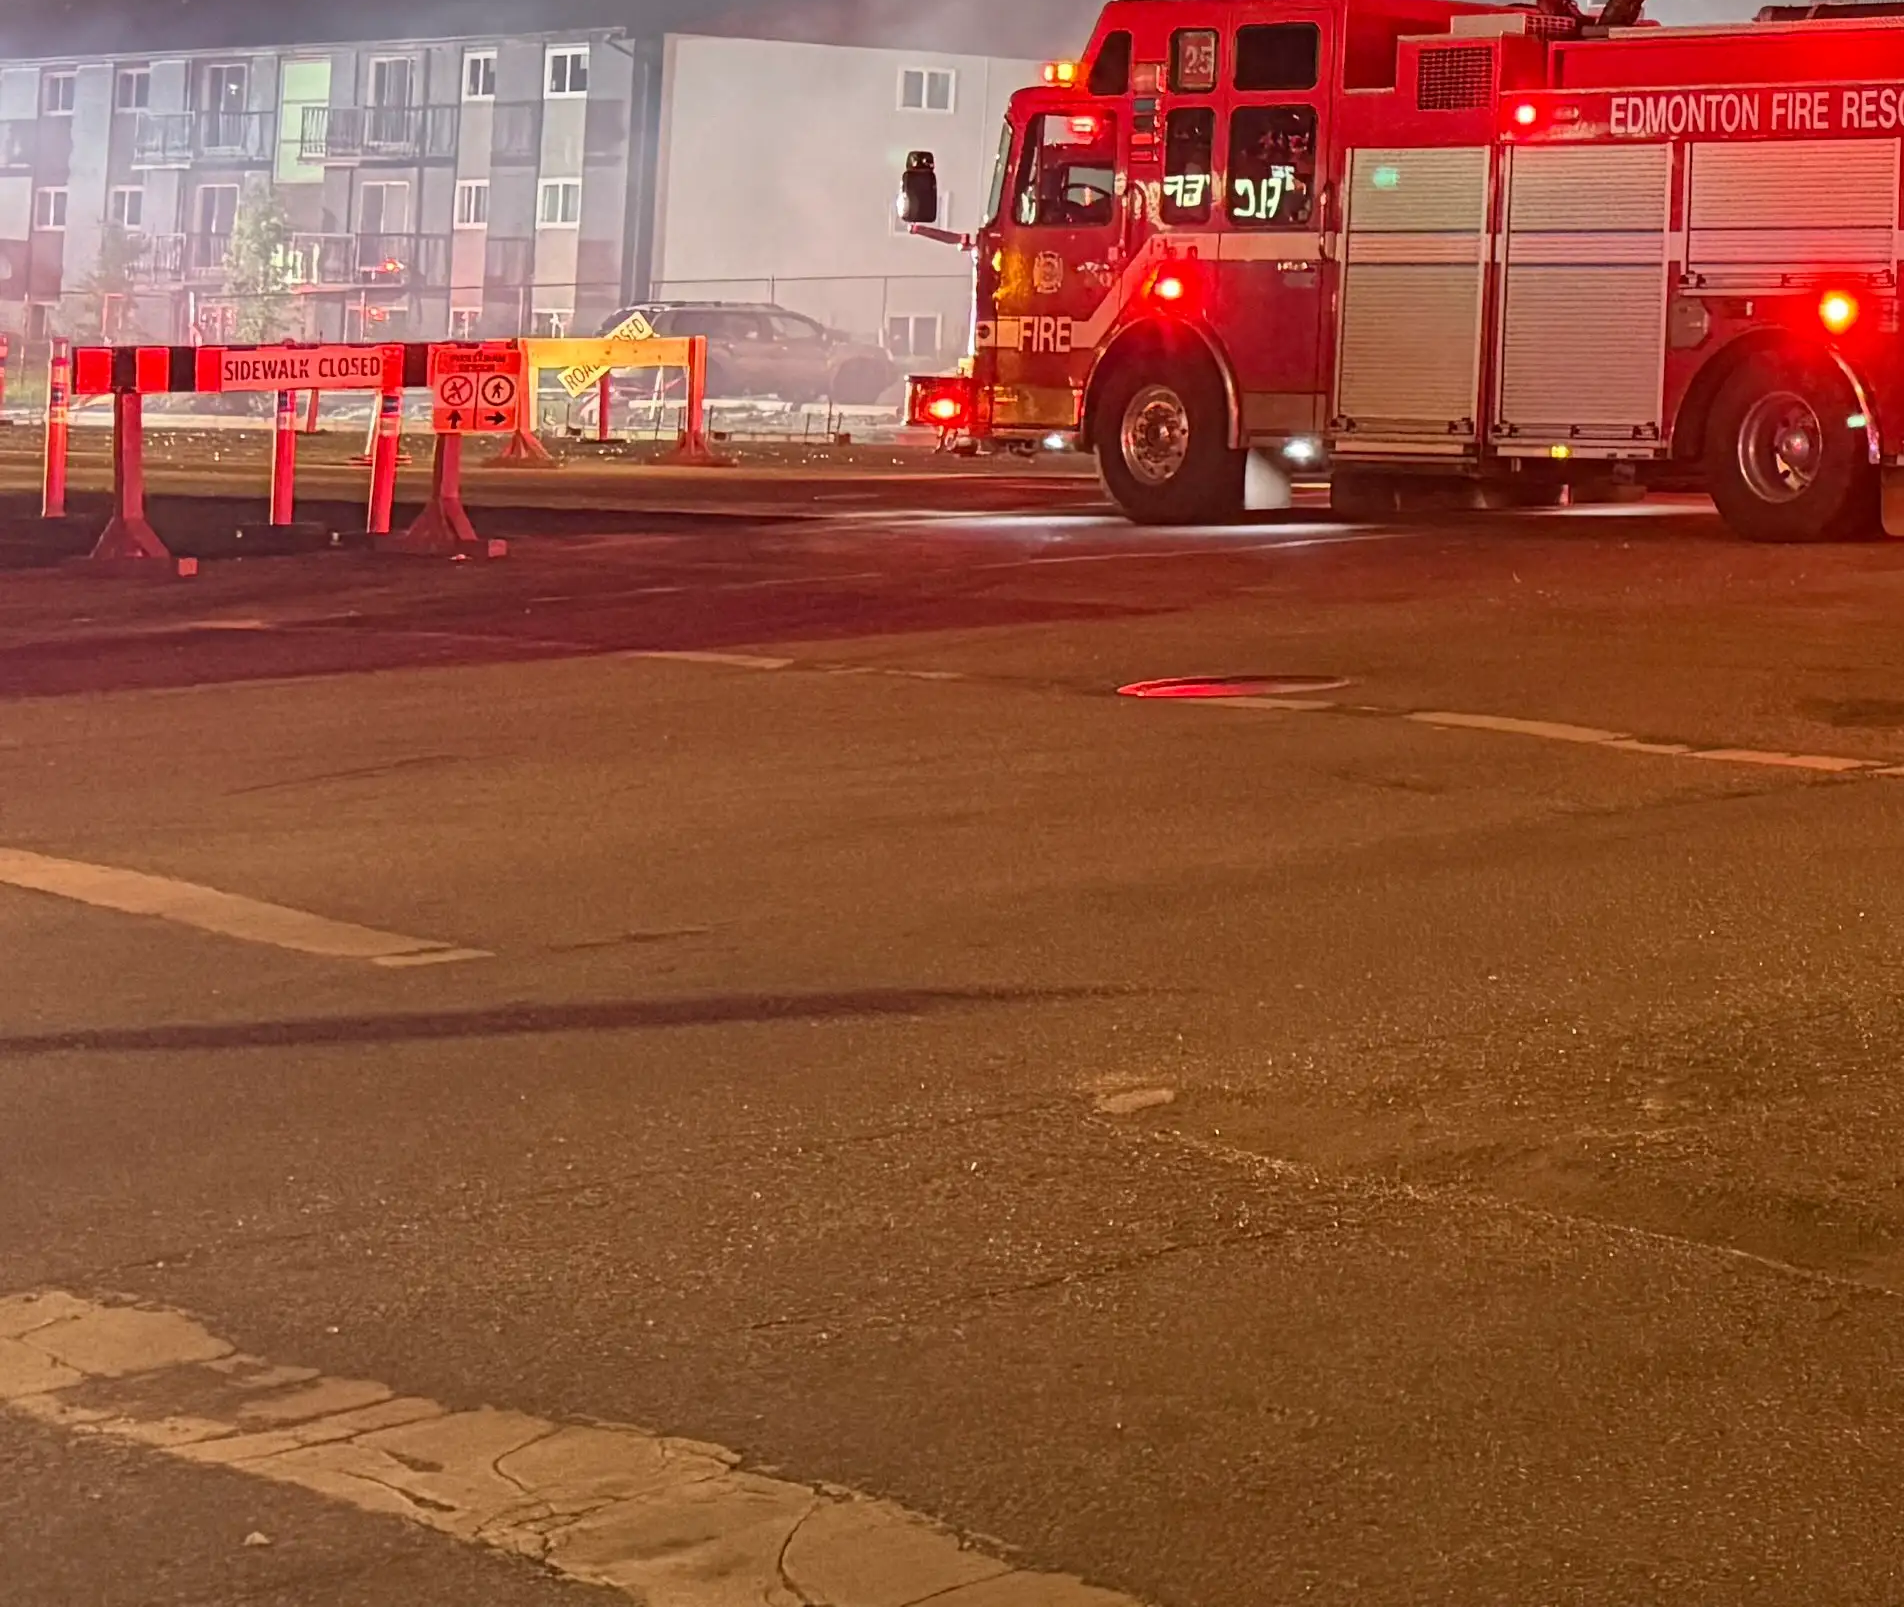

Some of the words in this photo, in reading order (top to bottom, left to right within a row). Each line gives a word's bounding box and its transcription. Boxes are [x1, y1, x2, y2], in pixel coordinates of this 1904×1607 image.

[1184, 44, 1214, 74] 25
[1610, 93, 1759, 135] EDMONTON
[1770, 91, 1830, 131] FIRE
[1018, 316, 1073, 353] FIRE
[223, 358, 310, 381] SIDEWALK
[318, 356, 381, 378] CLOSED
